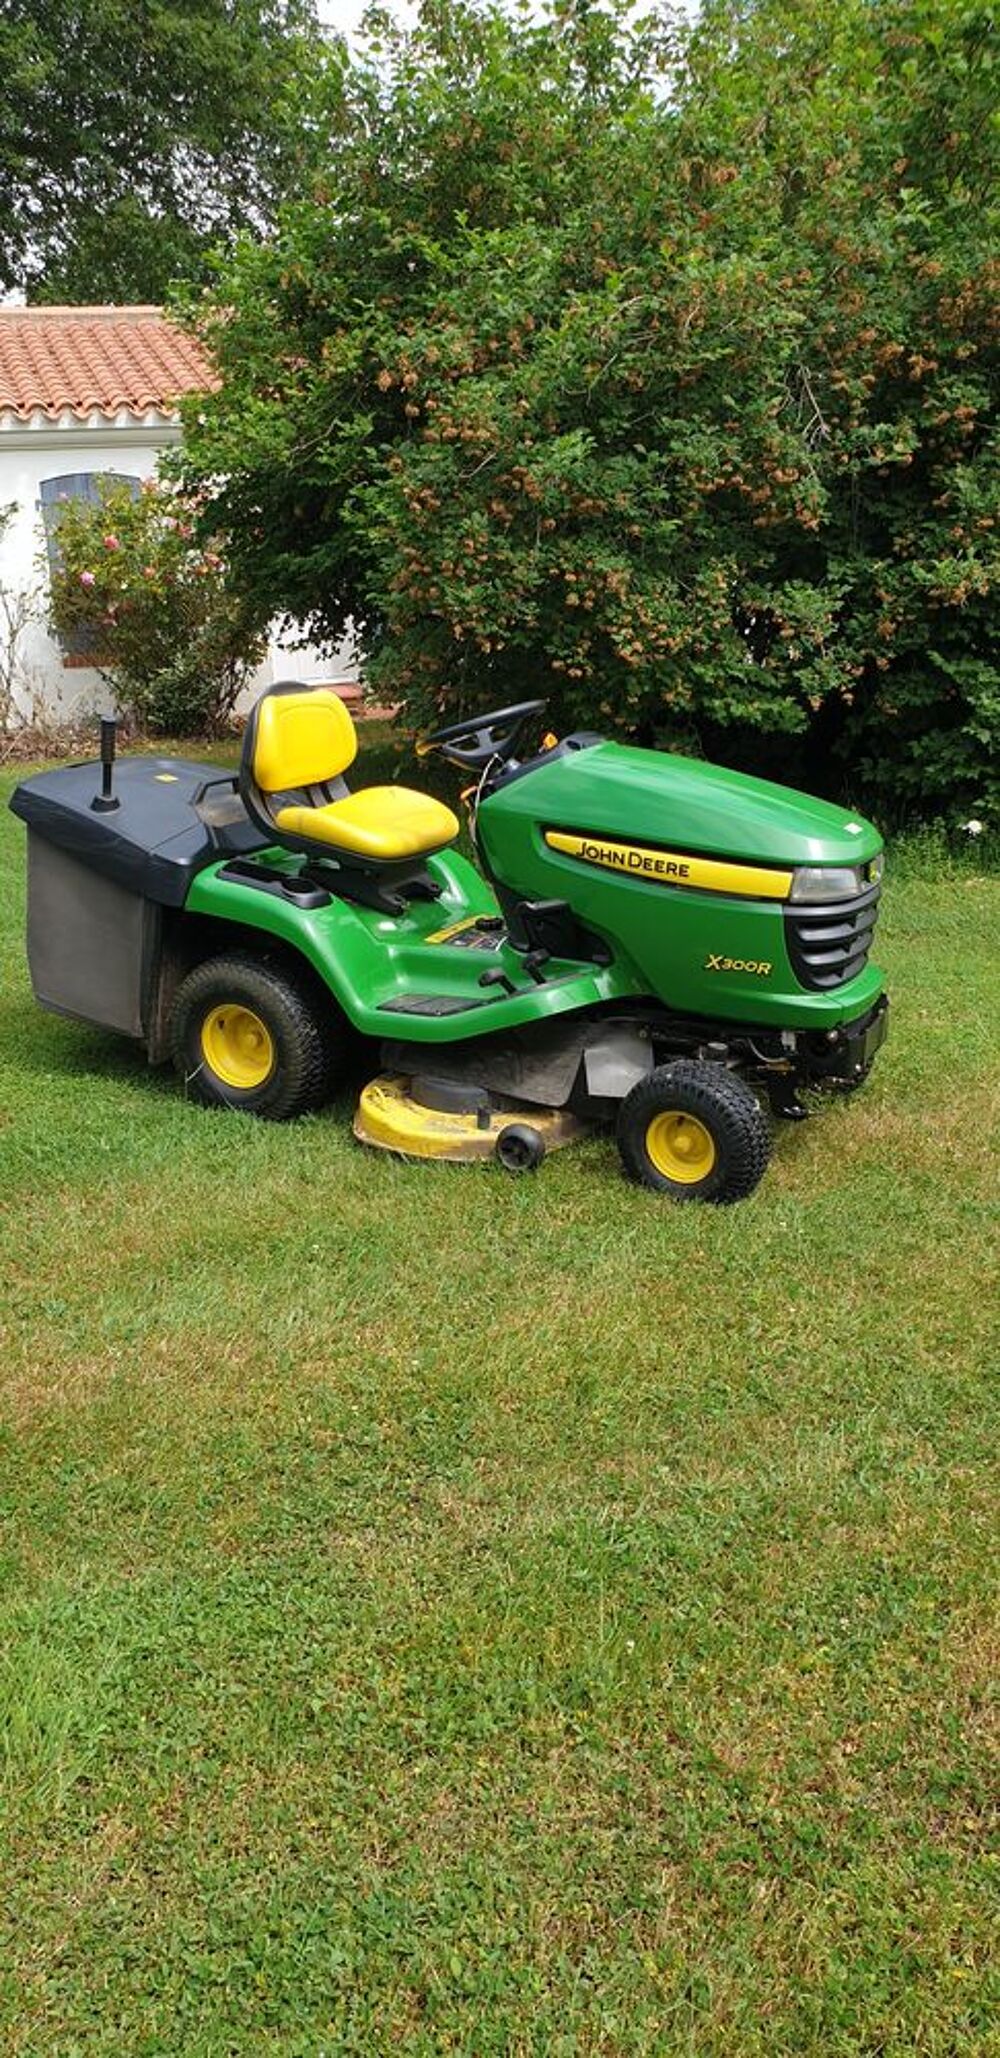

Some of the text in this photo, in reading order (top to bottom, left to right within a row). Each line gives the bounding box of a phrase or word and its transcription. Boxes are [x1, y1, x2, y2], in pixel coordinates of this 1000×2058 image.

[577, 842, 690, 878] JOHN DEERE
[705, 954, 771, 975] X300R
